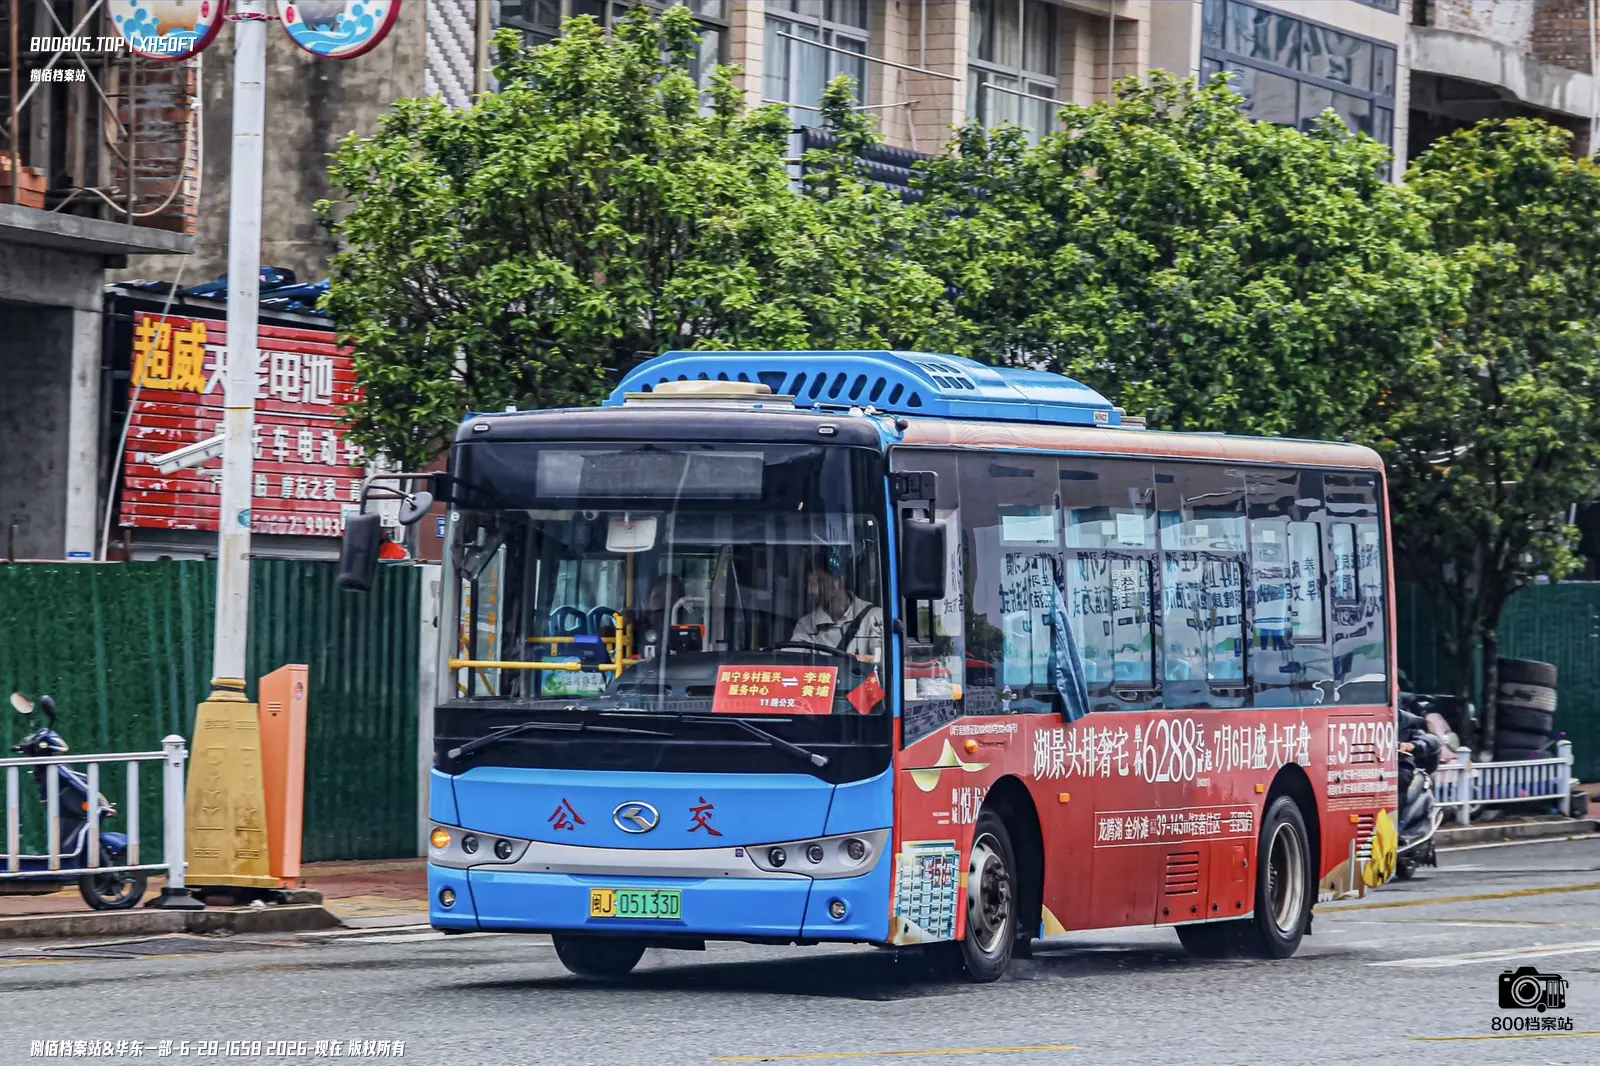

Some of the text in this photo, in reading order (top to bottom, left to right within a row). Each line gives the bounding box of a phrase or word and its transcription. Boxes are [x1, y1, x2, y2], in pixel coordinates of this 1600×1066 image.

[729, 684, 769, 696] 服务中心
[1033, 726, 1130, 781] 湖景头排奢宅
[1143, 717, 1196, 783] 6288
[1213, 720, 1312, 774] 7月6日盛大开盘
[548, 796, 724, 837] 公 交
